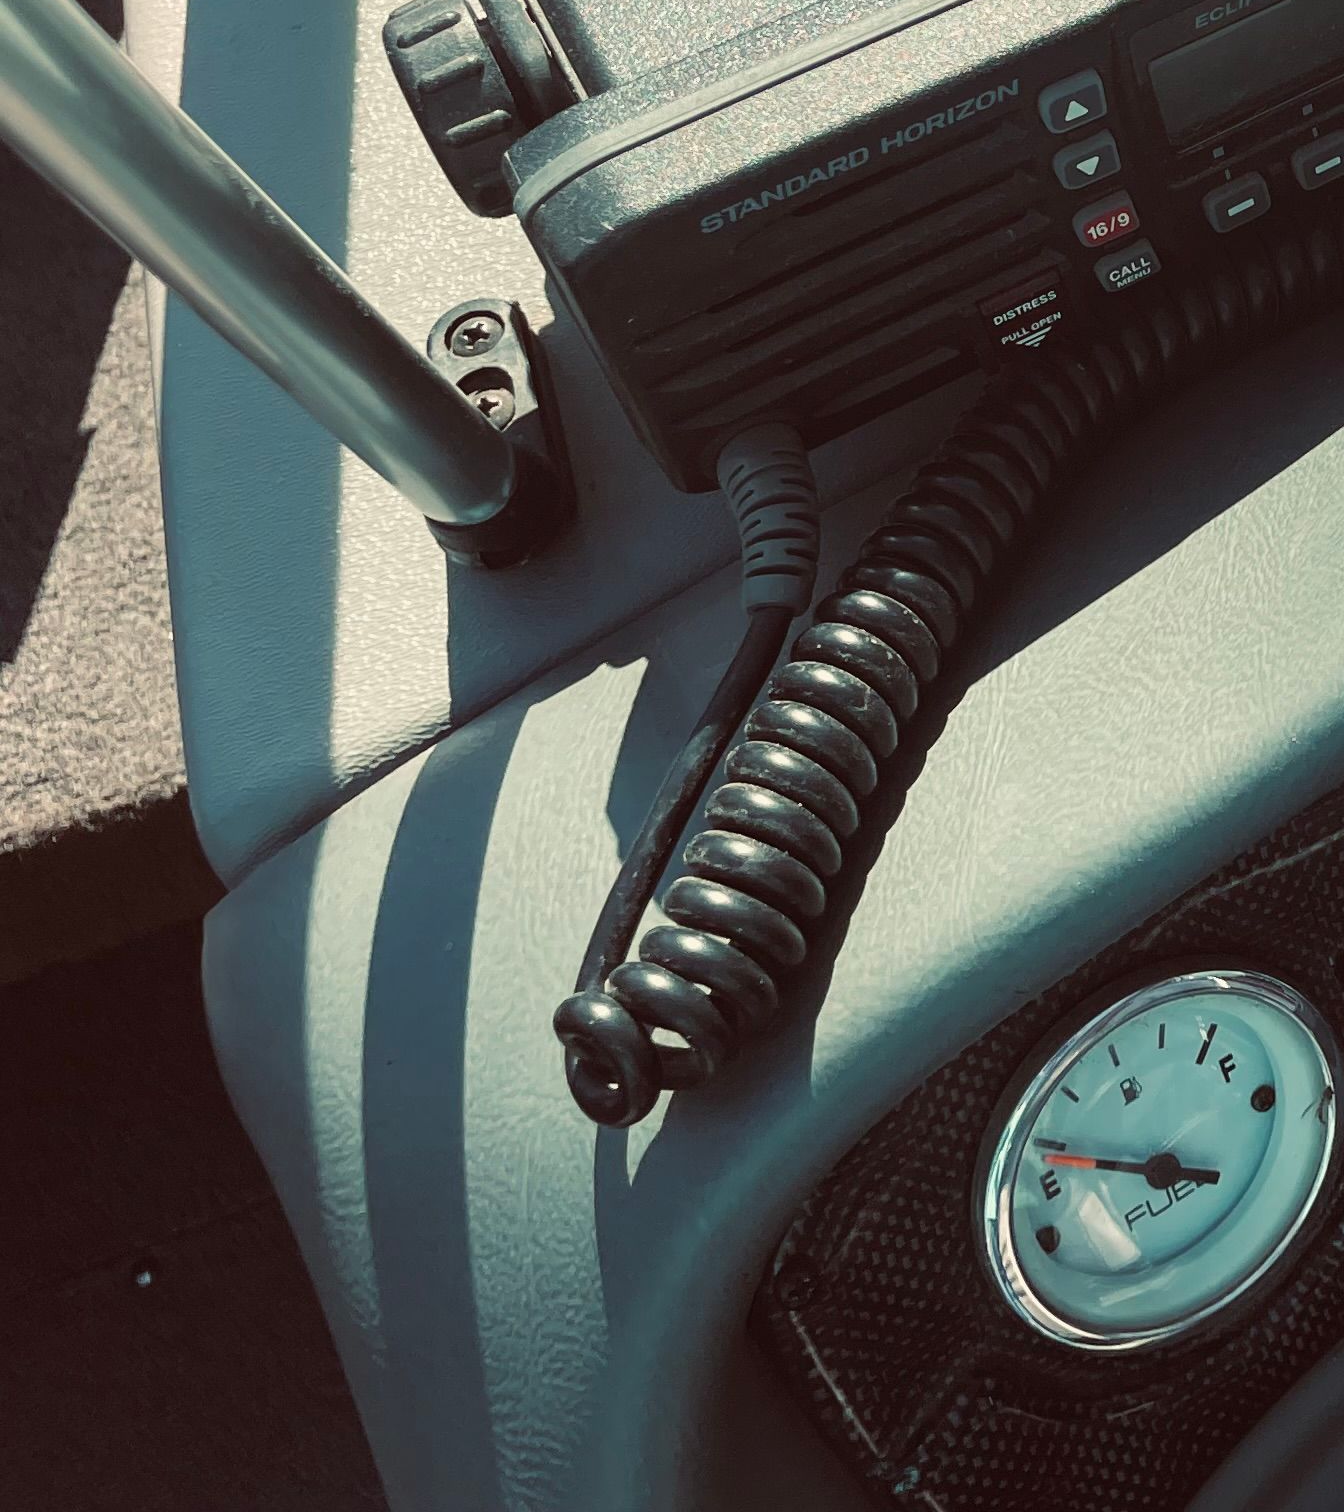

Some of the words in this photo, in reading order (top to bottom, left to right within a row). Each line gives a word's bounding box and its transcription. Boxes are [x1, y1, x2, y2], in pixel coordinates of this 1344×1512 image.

[701, 146, 870, 234] STANDARD
[881, 77, 1019, 155] HORIZON
[1087, 212, 1131, 240] 16/9
[1109, 257, 1151, 282] CALL
[1117, 266, 1151, 289] MENU
[993, 290, 1057, 326] DISTRESS
[1001, 328, 1030, 345] PULL
[1031, 311, 1062, 332] OPEN
[1218, 1052, 1237, 1084] F
[1040, 1169, 1062, 1201] E
[1124, 1179, 1206, 1232] FUE
